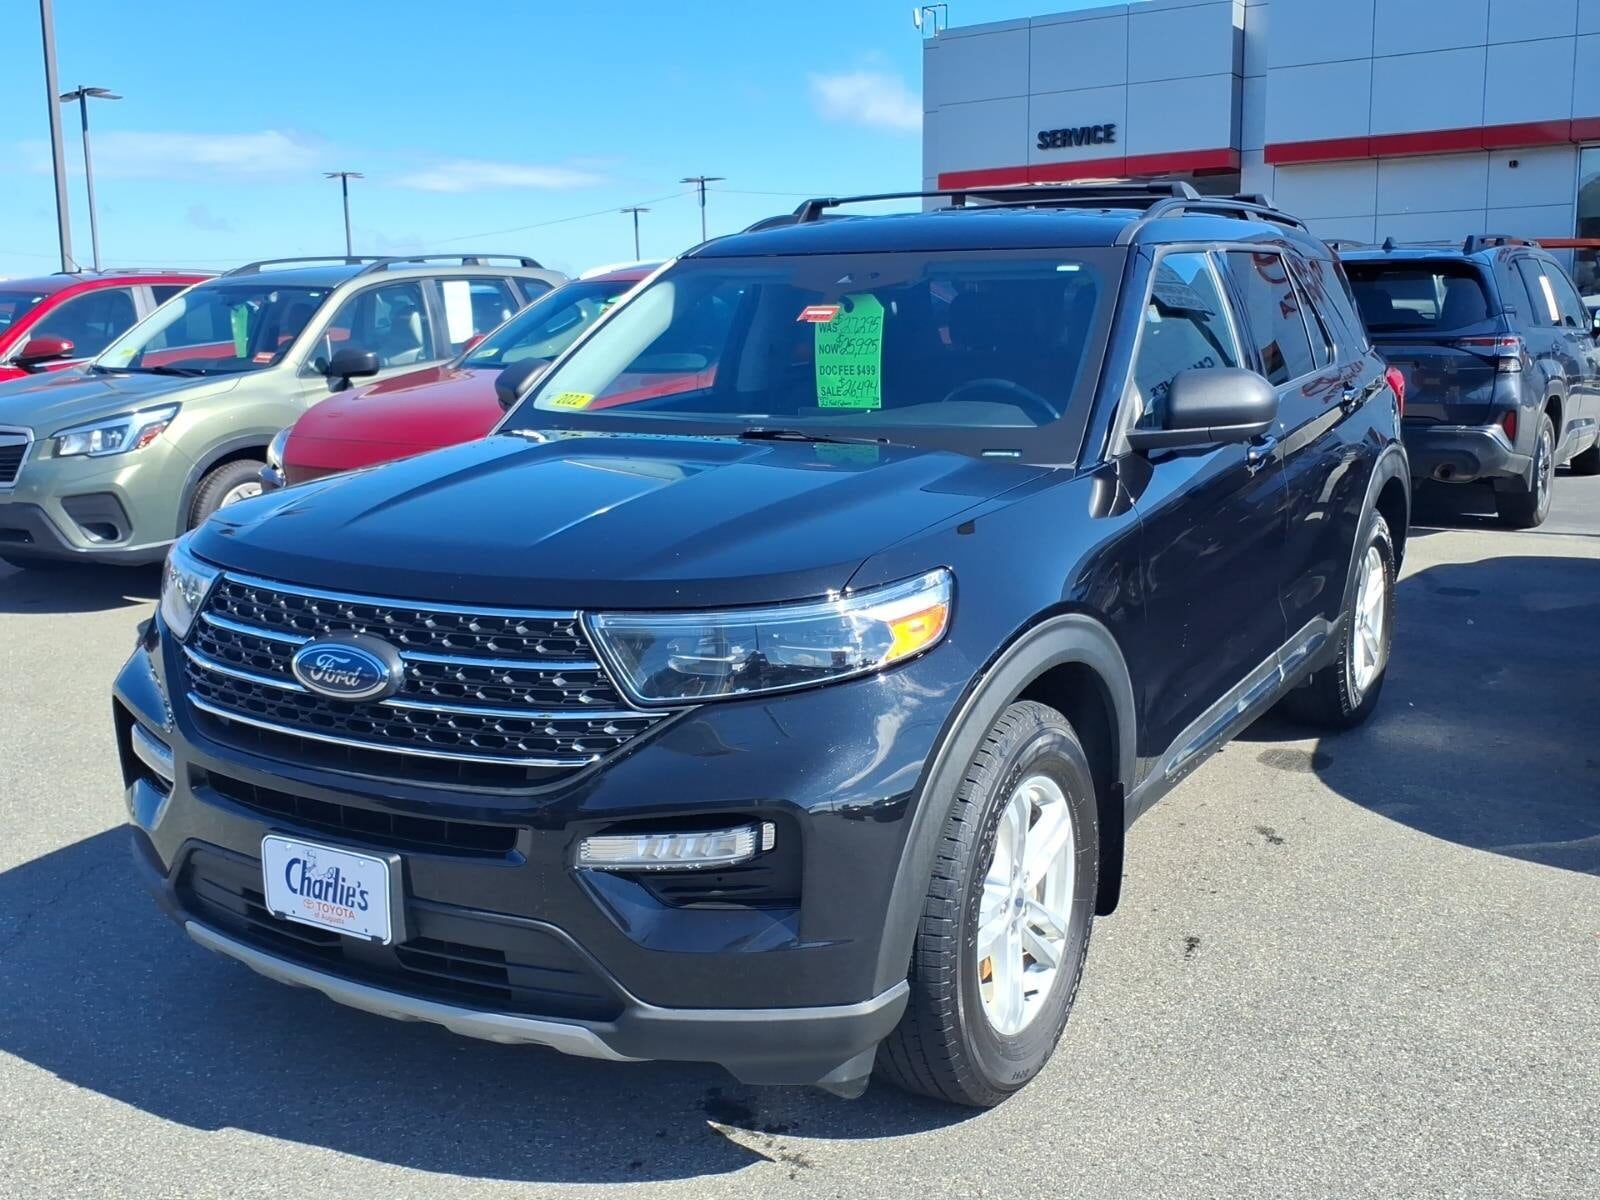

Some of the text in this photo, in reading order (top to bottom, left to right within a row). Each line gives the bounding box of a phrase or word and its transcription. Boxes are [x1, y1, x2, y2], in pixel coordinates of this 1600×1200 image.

[1037, 123, 1117, 150] SERVICE
[819, 322, 837, 334] WAS
[819, 343, 839, 355] NOW
[819, 365, 876, 376] DOC FEE $499
[820, 386, 842, 397] SALE
[556, 393, 586, 406] 2022
[309, 653, 363, 687] Ford
[284, 857, 369, 912] Charlie's
[316, 900, 357, 921] TOYOTA
